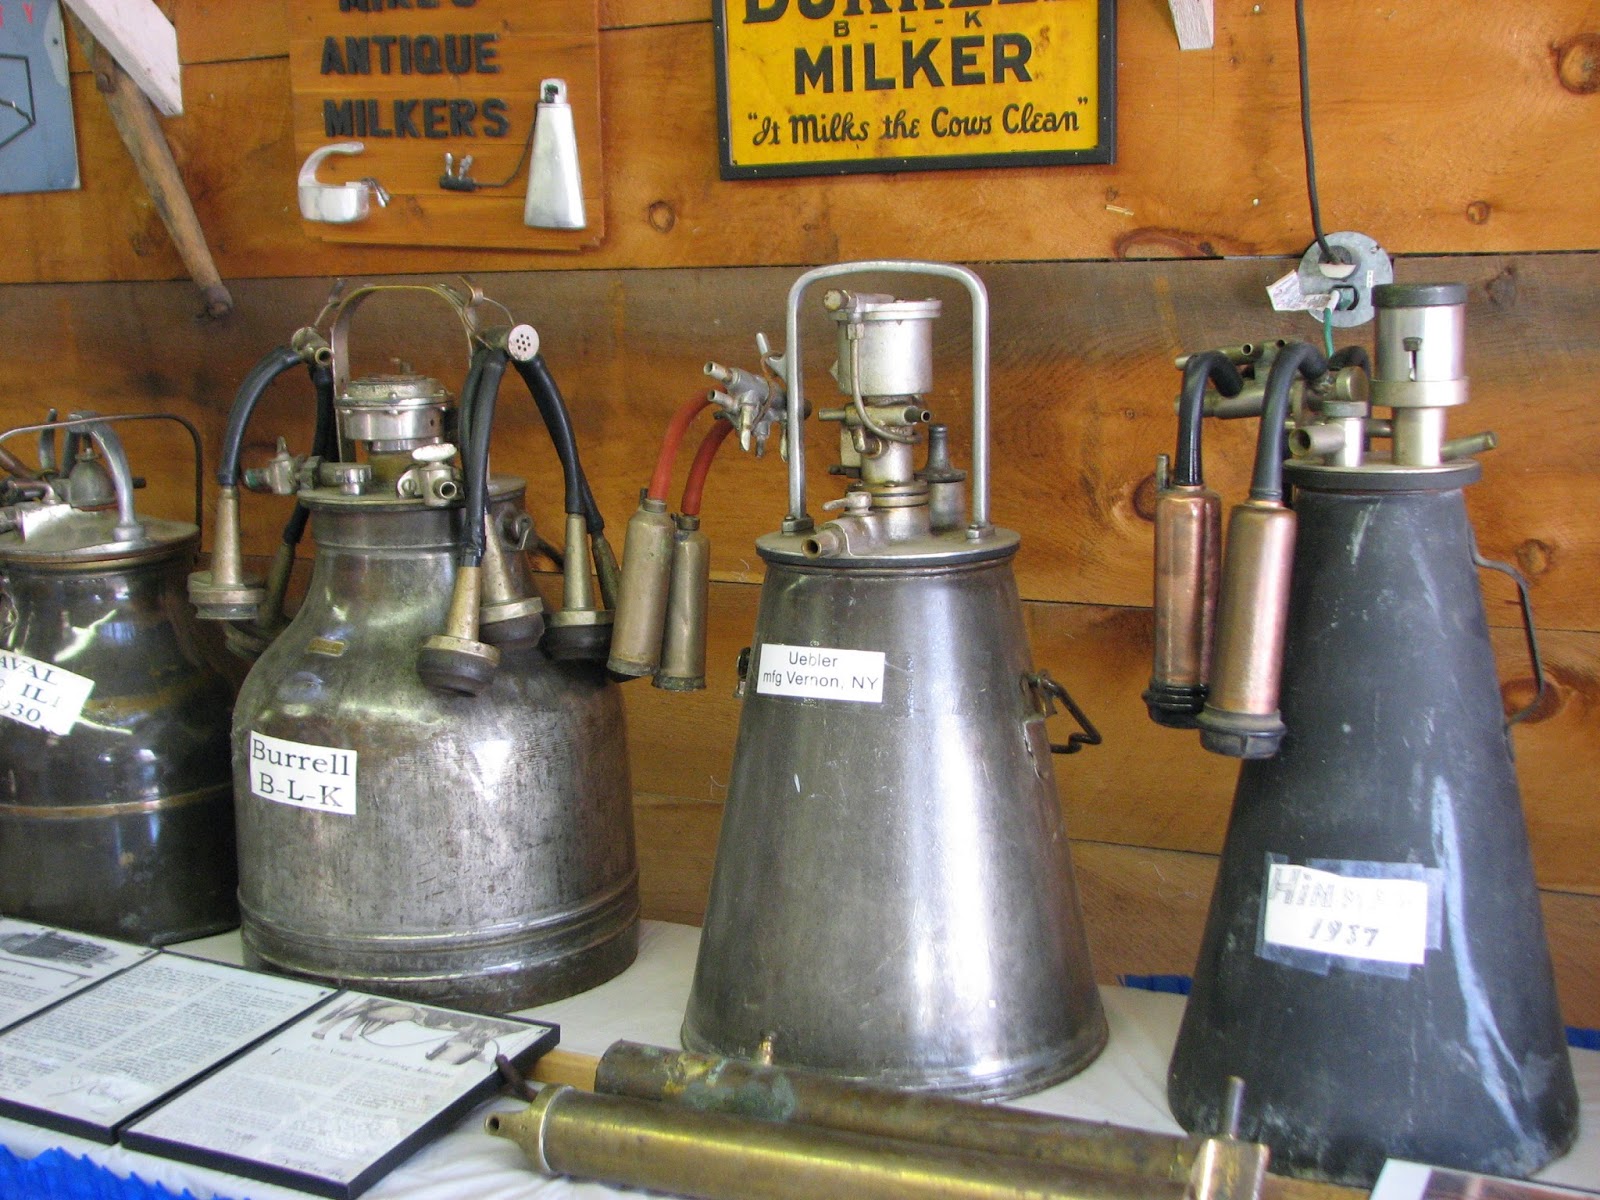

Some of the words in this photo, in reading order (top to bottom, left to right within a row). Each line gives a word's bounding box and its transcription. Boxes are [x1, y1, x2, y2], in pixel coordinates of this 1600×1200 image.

[320, 33, 502, 75] ANTIQUE
[794, 32, 1033, 95] MILKER
[323, 98, 510, 138] MILKERS
[788, 111, 870, 144] Milks
[878, 109, 920, 140] the
[931, 106, 992, 138] Cows
[789, 651, 838, 667] Uebler
[762, 670, 782, 686] mfg
[786, 671, 844, 689] Vernon,
[852, 676, 879, 690] NY
[252, 738, 350, 776] Burrell
[259, 771, 343, 807] B-L-K
